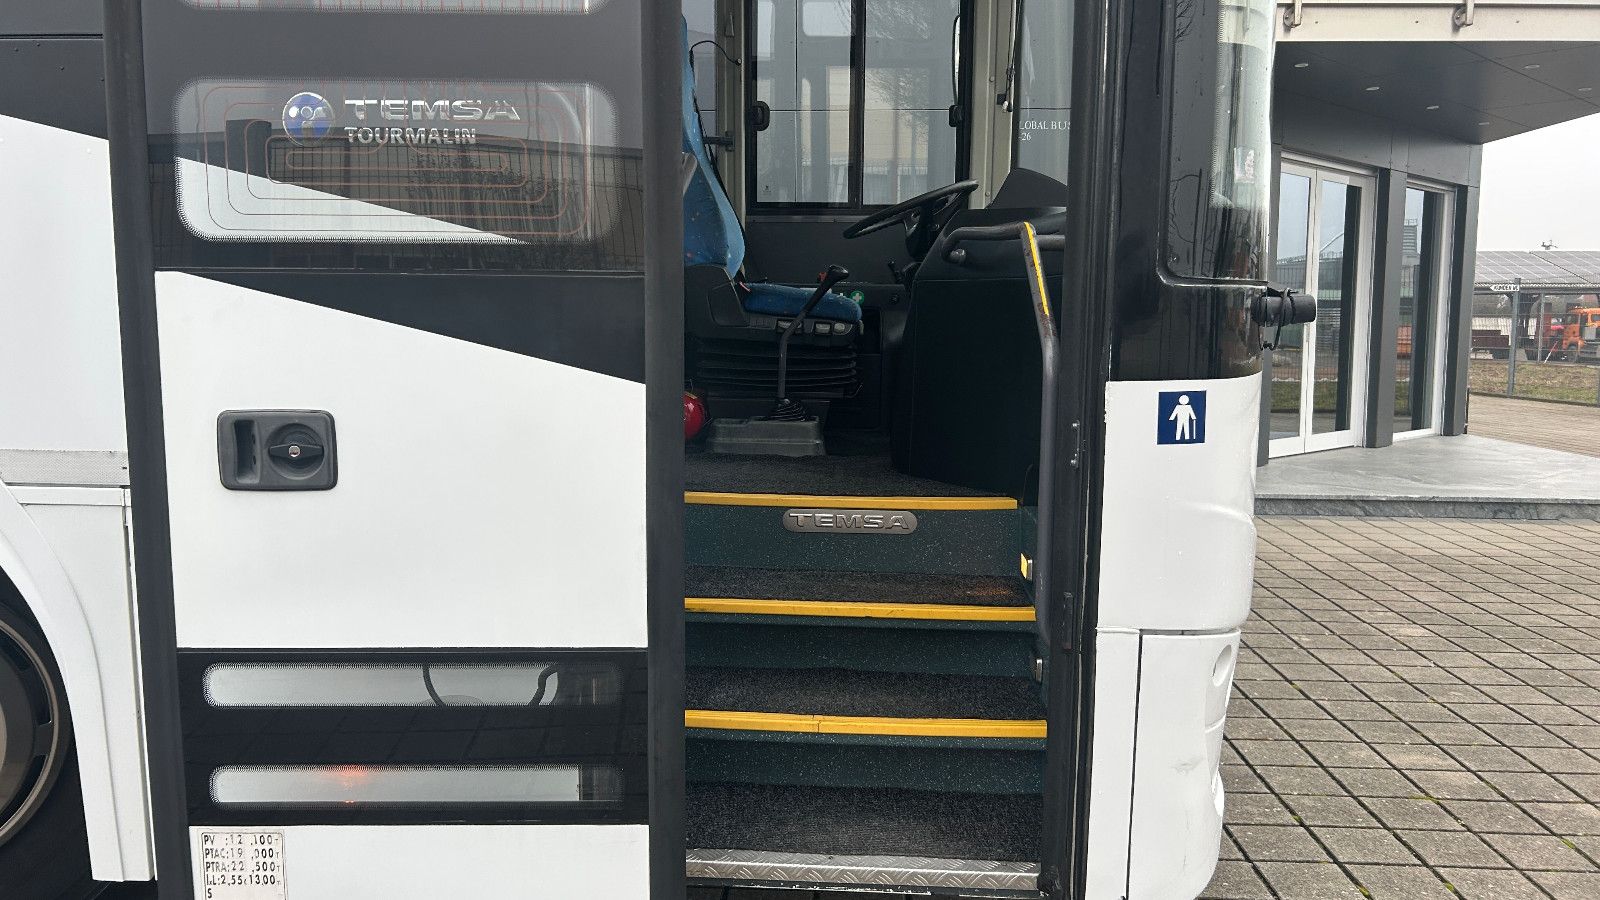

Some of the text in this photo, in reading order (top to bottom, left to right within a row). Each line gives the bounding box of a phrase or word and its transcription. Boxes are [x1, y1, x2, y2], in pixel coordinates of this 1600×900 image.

[344, 99, 521, 121] TEMSA
[1019, 120, 1049, 130] LOBAL
[344, 127, 476, 144] TOURMALIN
[789, 513, 910, 530] TEMSA
[203, 834, 215, 845] PV
[207, 887, 213, 899] S
